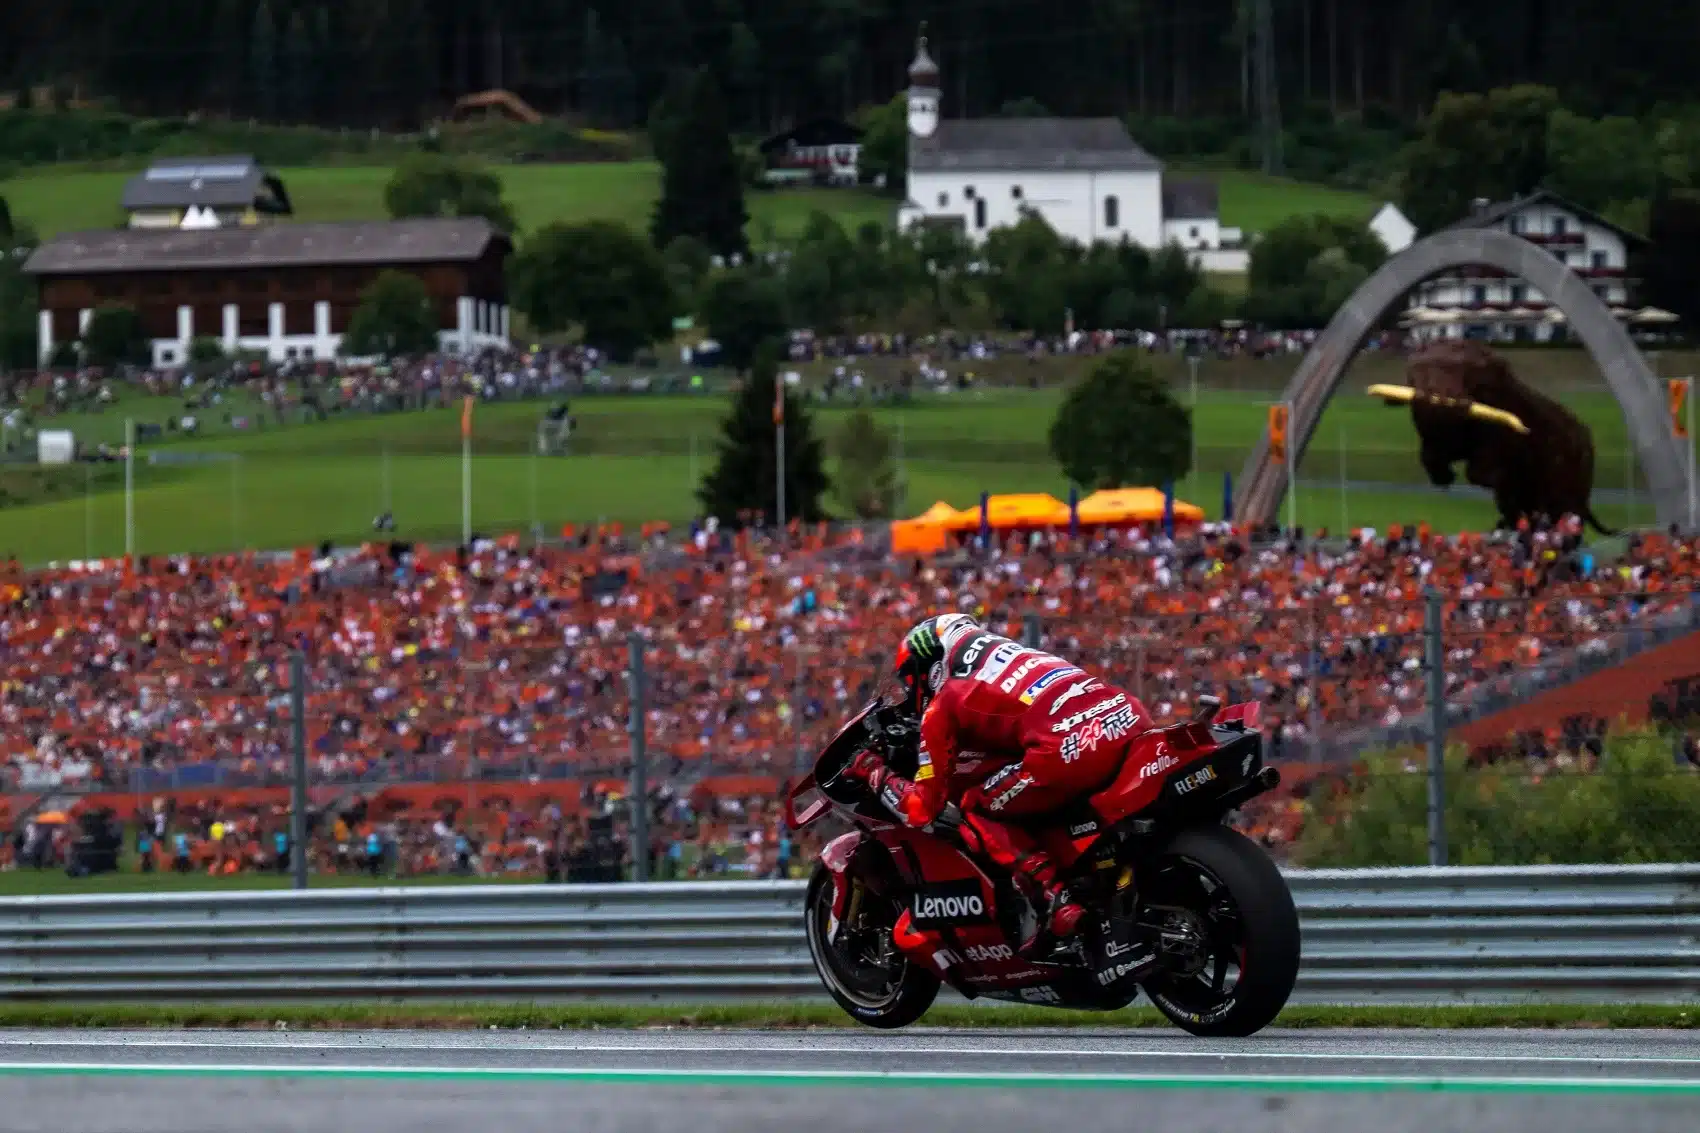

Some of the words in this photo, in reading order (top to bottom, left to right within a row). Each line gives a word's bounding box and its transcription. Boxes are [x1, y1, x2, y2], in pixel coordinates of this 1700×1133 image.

[1051, 692, 1127, 733] alpinestars
[1139, 754, 1171, 779] riello
[914, 892, 984, 919] Lenovo
